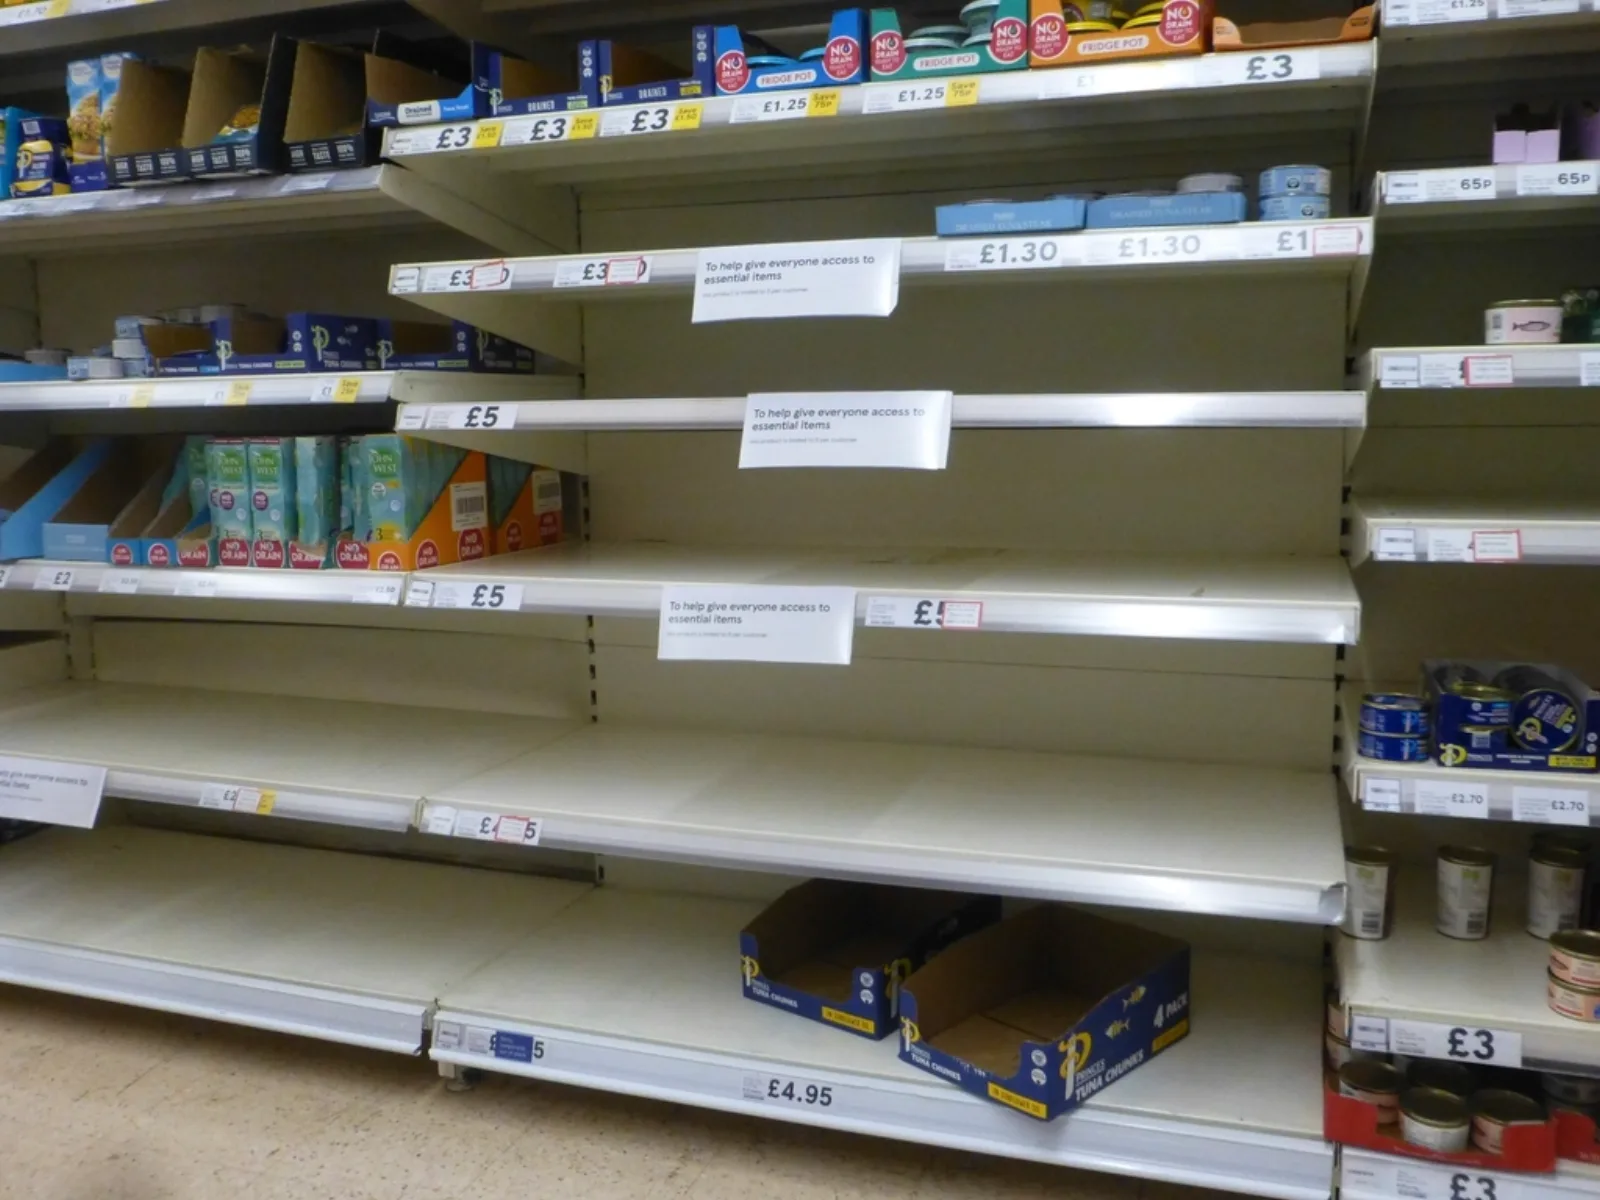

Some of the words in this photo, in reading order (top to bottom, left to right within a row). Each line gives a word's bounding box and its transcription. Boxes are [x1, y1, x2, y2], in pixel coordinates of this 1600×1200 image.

[1167, 6, 1192, 19] NO
[997, 25, 1020, 38] NO
[1036, 22, 1060, 34] NO
[876, 37, 898, 50] NO
[1082, 42, 1119, 53] FRIDGE
[1123, 38, 1144, 46] POT
[831, 43, 852, 59] NO
[722, 58, 742, 72] NO
[919, 58, 952, 68] FRIDGE
[956, 56, 975, 65] POT
[1246, 54, 1292, 80] £3
[761, 74, 791, 84] FRIDGE
[795, 71, 812, 81] POT
[952, 81, 976, 90] Save
[639, 86, 667, 99] DRAINED
[813, 92, 836, 101] Save
[898, 87, 945, 102] £1.25
[404, 104, 432, 115] Drained
[763, 98, 807, 113] £1.25
[631, 109, 669, 131] £3
[530, 118, 566, 140] £3
[436, 127, 472, 149] £3
[1461, 179, 1492, 190] 65p
[1558, 173, 1590, 186] 65p
[980, 240, 1057, 263] £1.30
[1119, 235, 1200, 257] £1.30
[706, 263, 717, 271] To
[720, 261, 742, 273] help
[745, 260, 766, 272] give
[769, 258, 818, 271] everyone
[822, 256, 860, 266] access
[863, 255, 875, 264] to
[704, 273, 749, 284] essential
[752, 271, 782, 282] items
[464, 406, 500, 428] £5
[754, 409, 765, 418] To
[768, 408, 791, 420] help
[794, 408, 815, 419] give
[818, 408, 868, 419] everyone
[871, 408, 909, 417] access
[913, 407, 925, 416] to
[752, 421, 798, 431] essential
[801, 420, 830, 430] items
[373, 464, 396, 473] WEST
[226, 543, 240, 554] NO
[260, 542, 275, 553] NO
[345, 544, 360, 554] NO
[222, 551, 248, 560] DRAIN
[256, 552, 281, 561] DRAIN
[340, 552, 367, 562] DRAIN
[54, 572, 71, 585] £2
[472, 584, 504, 608] £5
[670, 602, 681, 611] To
[683, 601, 705, 613] help
[707, 602, 727, 613] give
[730, 602, 777, 614] everyone
[780, 603, 816, 613] access
[819, 603, 831, 613] to
[669, 614, 711, 624] essential
[714, 614, 742, 625] items
[1451, 794, 1483, 804] £2.70
[1552, 800, 1584, 811] £2.70
[752, 986, 770, 998] TUNA
[1153, 1004, 1165, 1028] 4
[1166, 993, 1188, 1018] PACK
[1448, 1026, 1495, 1061] £3
[911, 1053, 931, 1068] TUNA
[931, 1061, 962, 1082] CHUNKS
[1075, 1077, 1103, 1103] TUNA
[1105, 1048, 1145, 1083] CHUNKS
[768, 1079, 833, 1107] £4.95
[1450, 1173, 1497, 1200] £3
